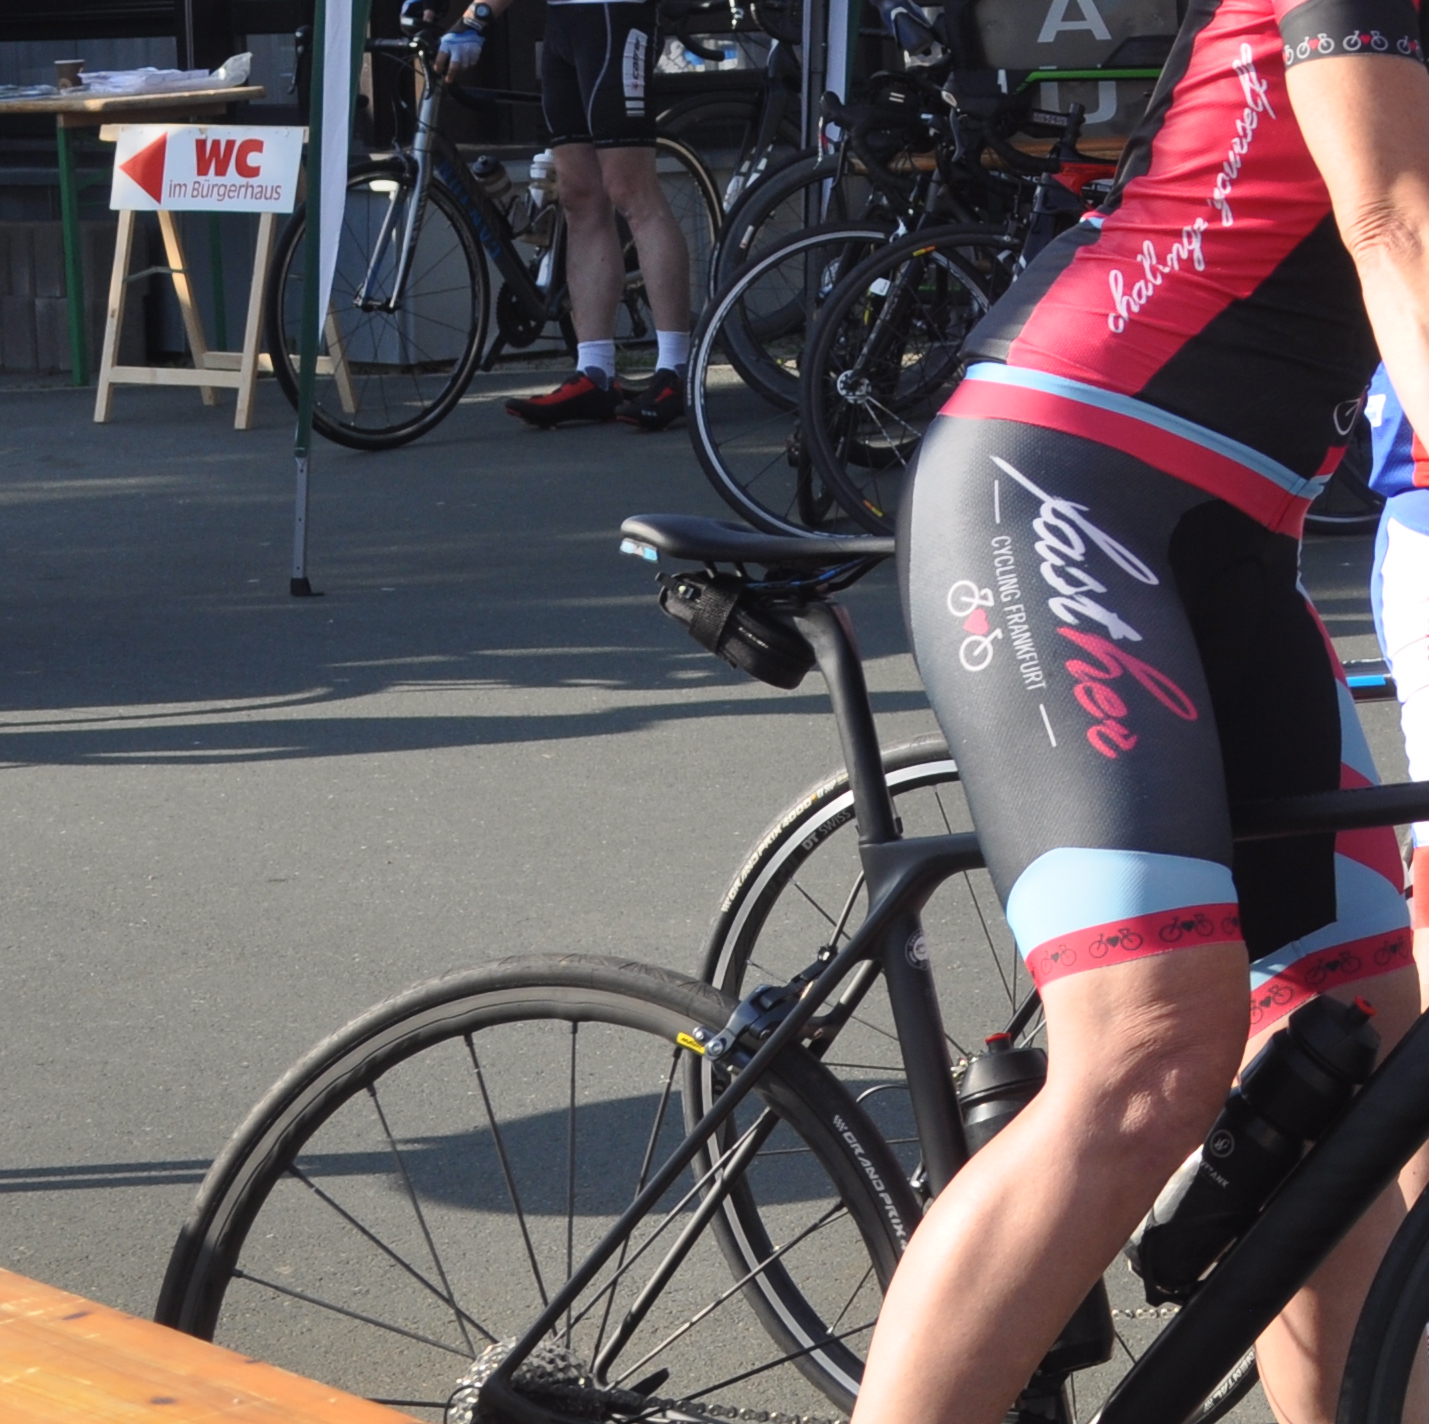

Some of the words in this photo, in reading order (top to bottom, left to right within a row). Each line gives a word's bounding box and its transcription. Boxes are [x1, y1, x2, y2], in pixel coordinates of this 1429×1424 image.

[195, 137, 264, 178] WC
[1208, 42, 1277, 228] yourself
[168, 178, 187, 198] im
[190, 177, 283, 202] Bürgerhaus
[991, 535, 1020, 602] CYCLING
[1002, 603, 1048, 691] FRANKFURT
[801, 832, 819, 851] DT
[818, 809, 852, 835] SWISS
[843, 1131, 882, 1194] GRAND
[879, 1192, 906, 1239] PRIX
